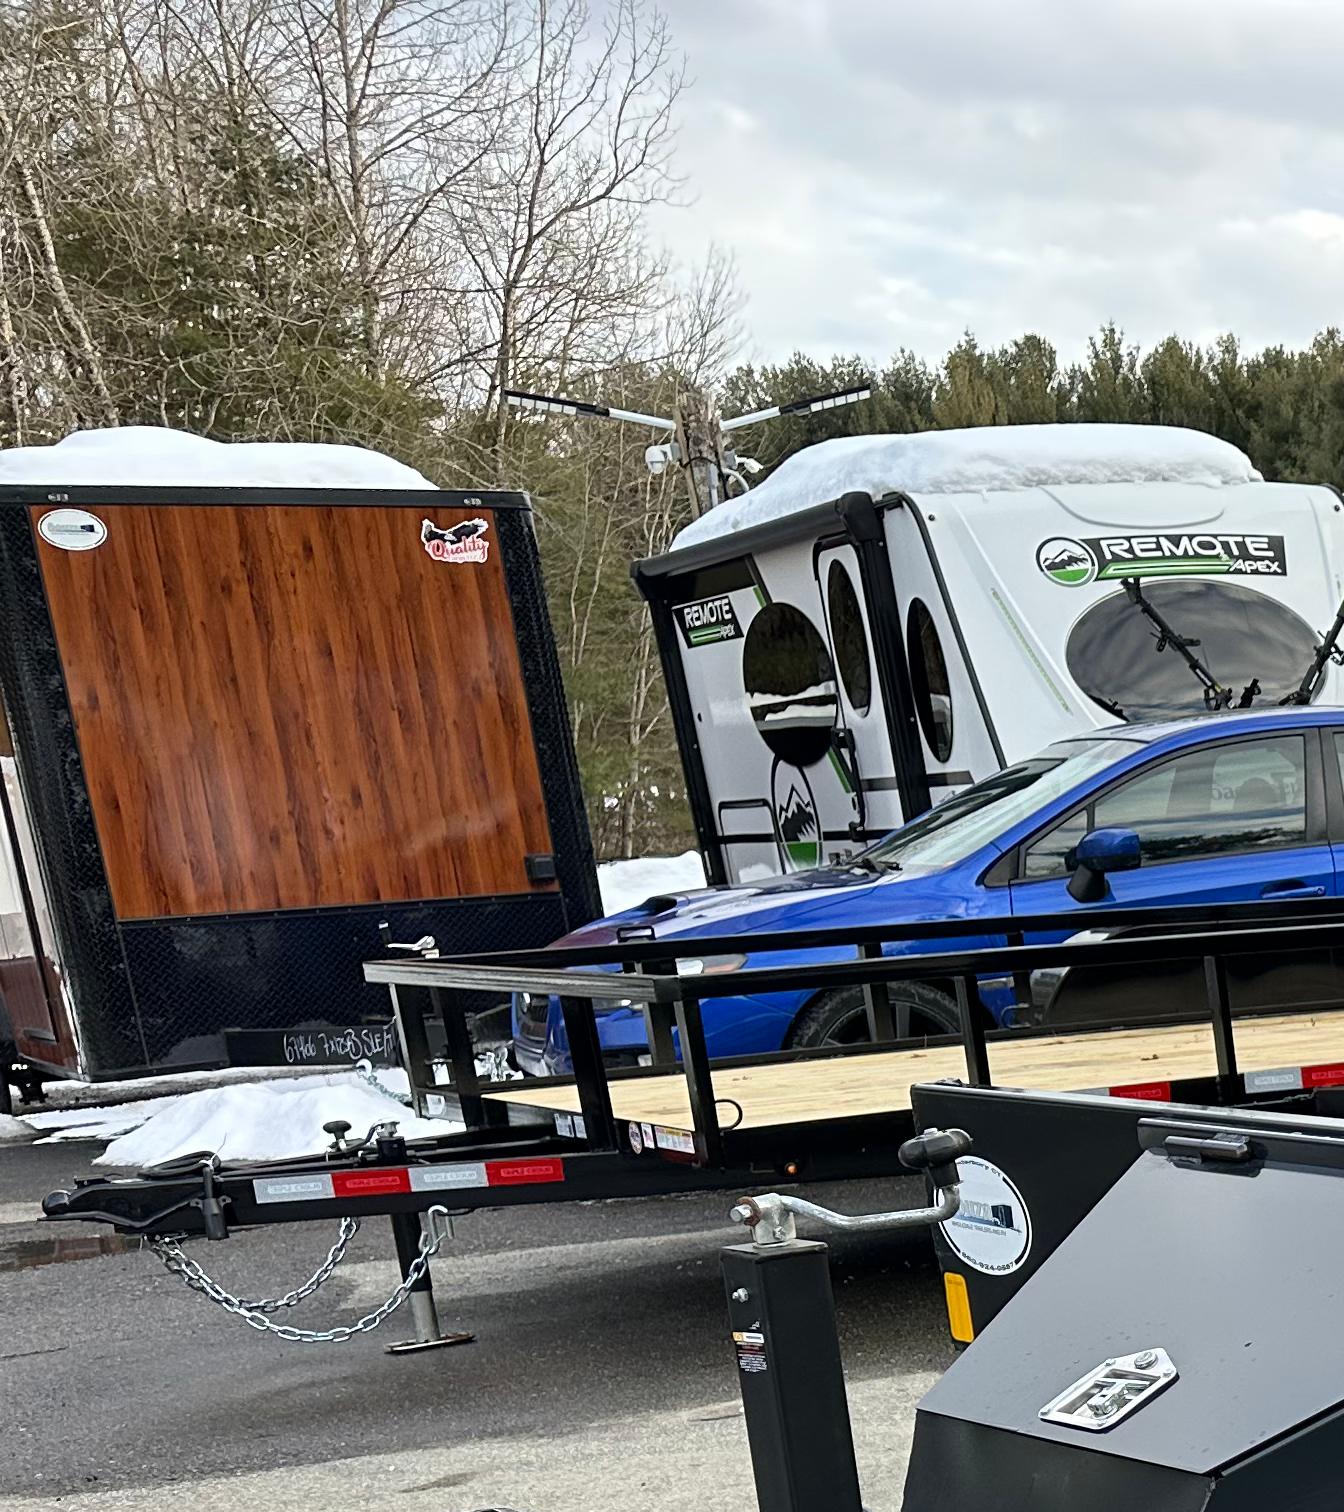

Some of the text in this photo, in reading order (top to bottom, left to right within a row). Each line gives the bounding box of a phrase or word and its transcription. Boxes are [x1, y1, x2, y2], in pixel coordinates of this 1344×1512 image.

[428, 537, 487, 559] Quality
[1099, 536, 1275, 559] REMOTE
[683, 598, 732, 628] REMOTE
